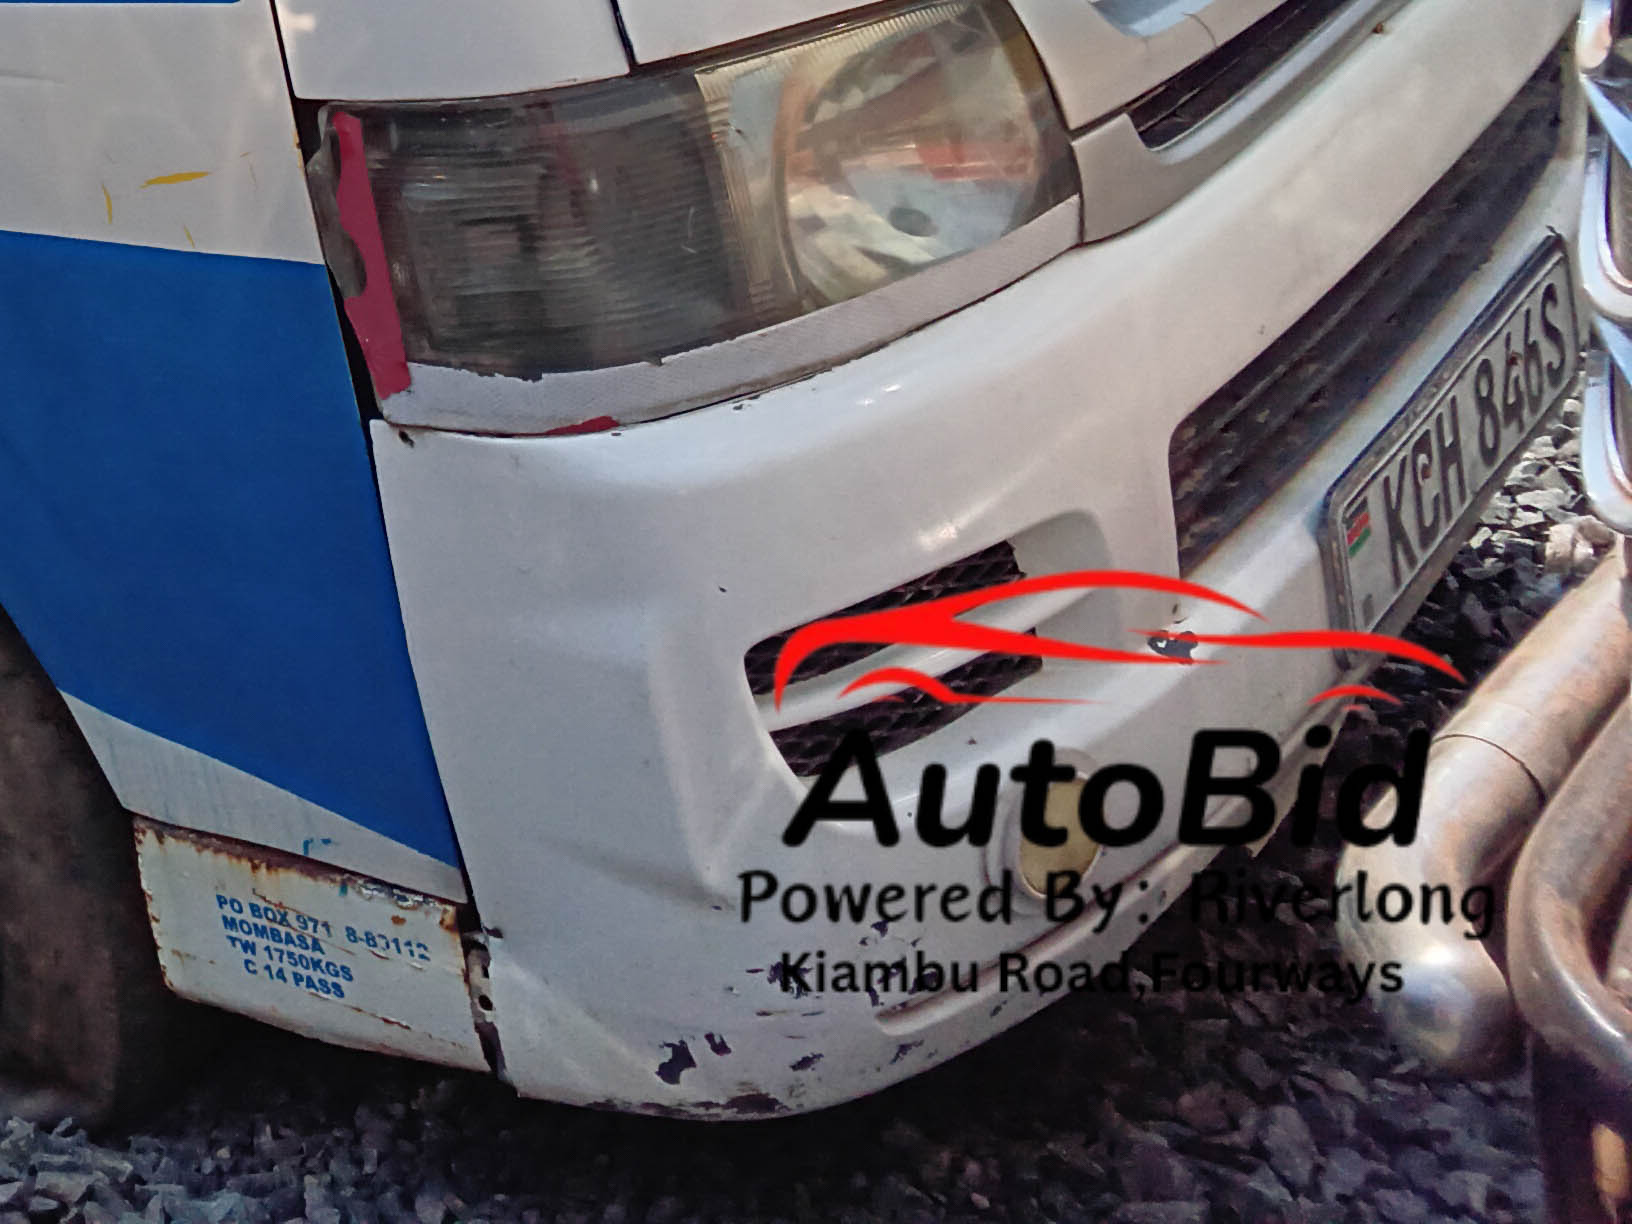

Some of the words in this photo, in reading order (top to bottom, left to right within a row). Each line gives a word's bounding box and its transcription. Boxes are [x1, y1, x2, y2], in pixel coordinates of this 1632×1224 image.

[1382, 394, 1468, 588] KCH
[1474, 282, 1567, 468] 846S
[215, 893, 244, 915] PO
[248, 901, 292, 928] BOX
[221, 913, 327, 956] MOMBASA
[225, 934, 258, 956] TW
[263, 944, 355, 982] 1750KGS
[244, 959, 259, 977] C
[264, 963, 288, 985] 14
[293, 971, 345, 998] PASS
